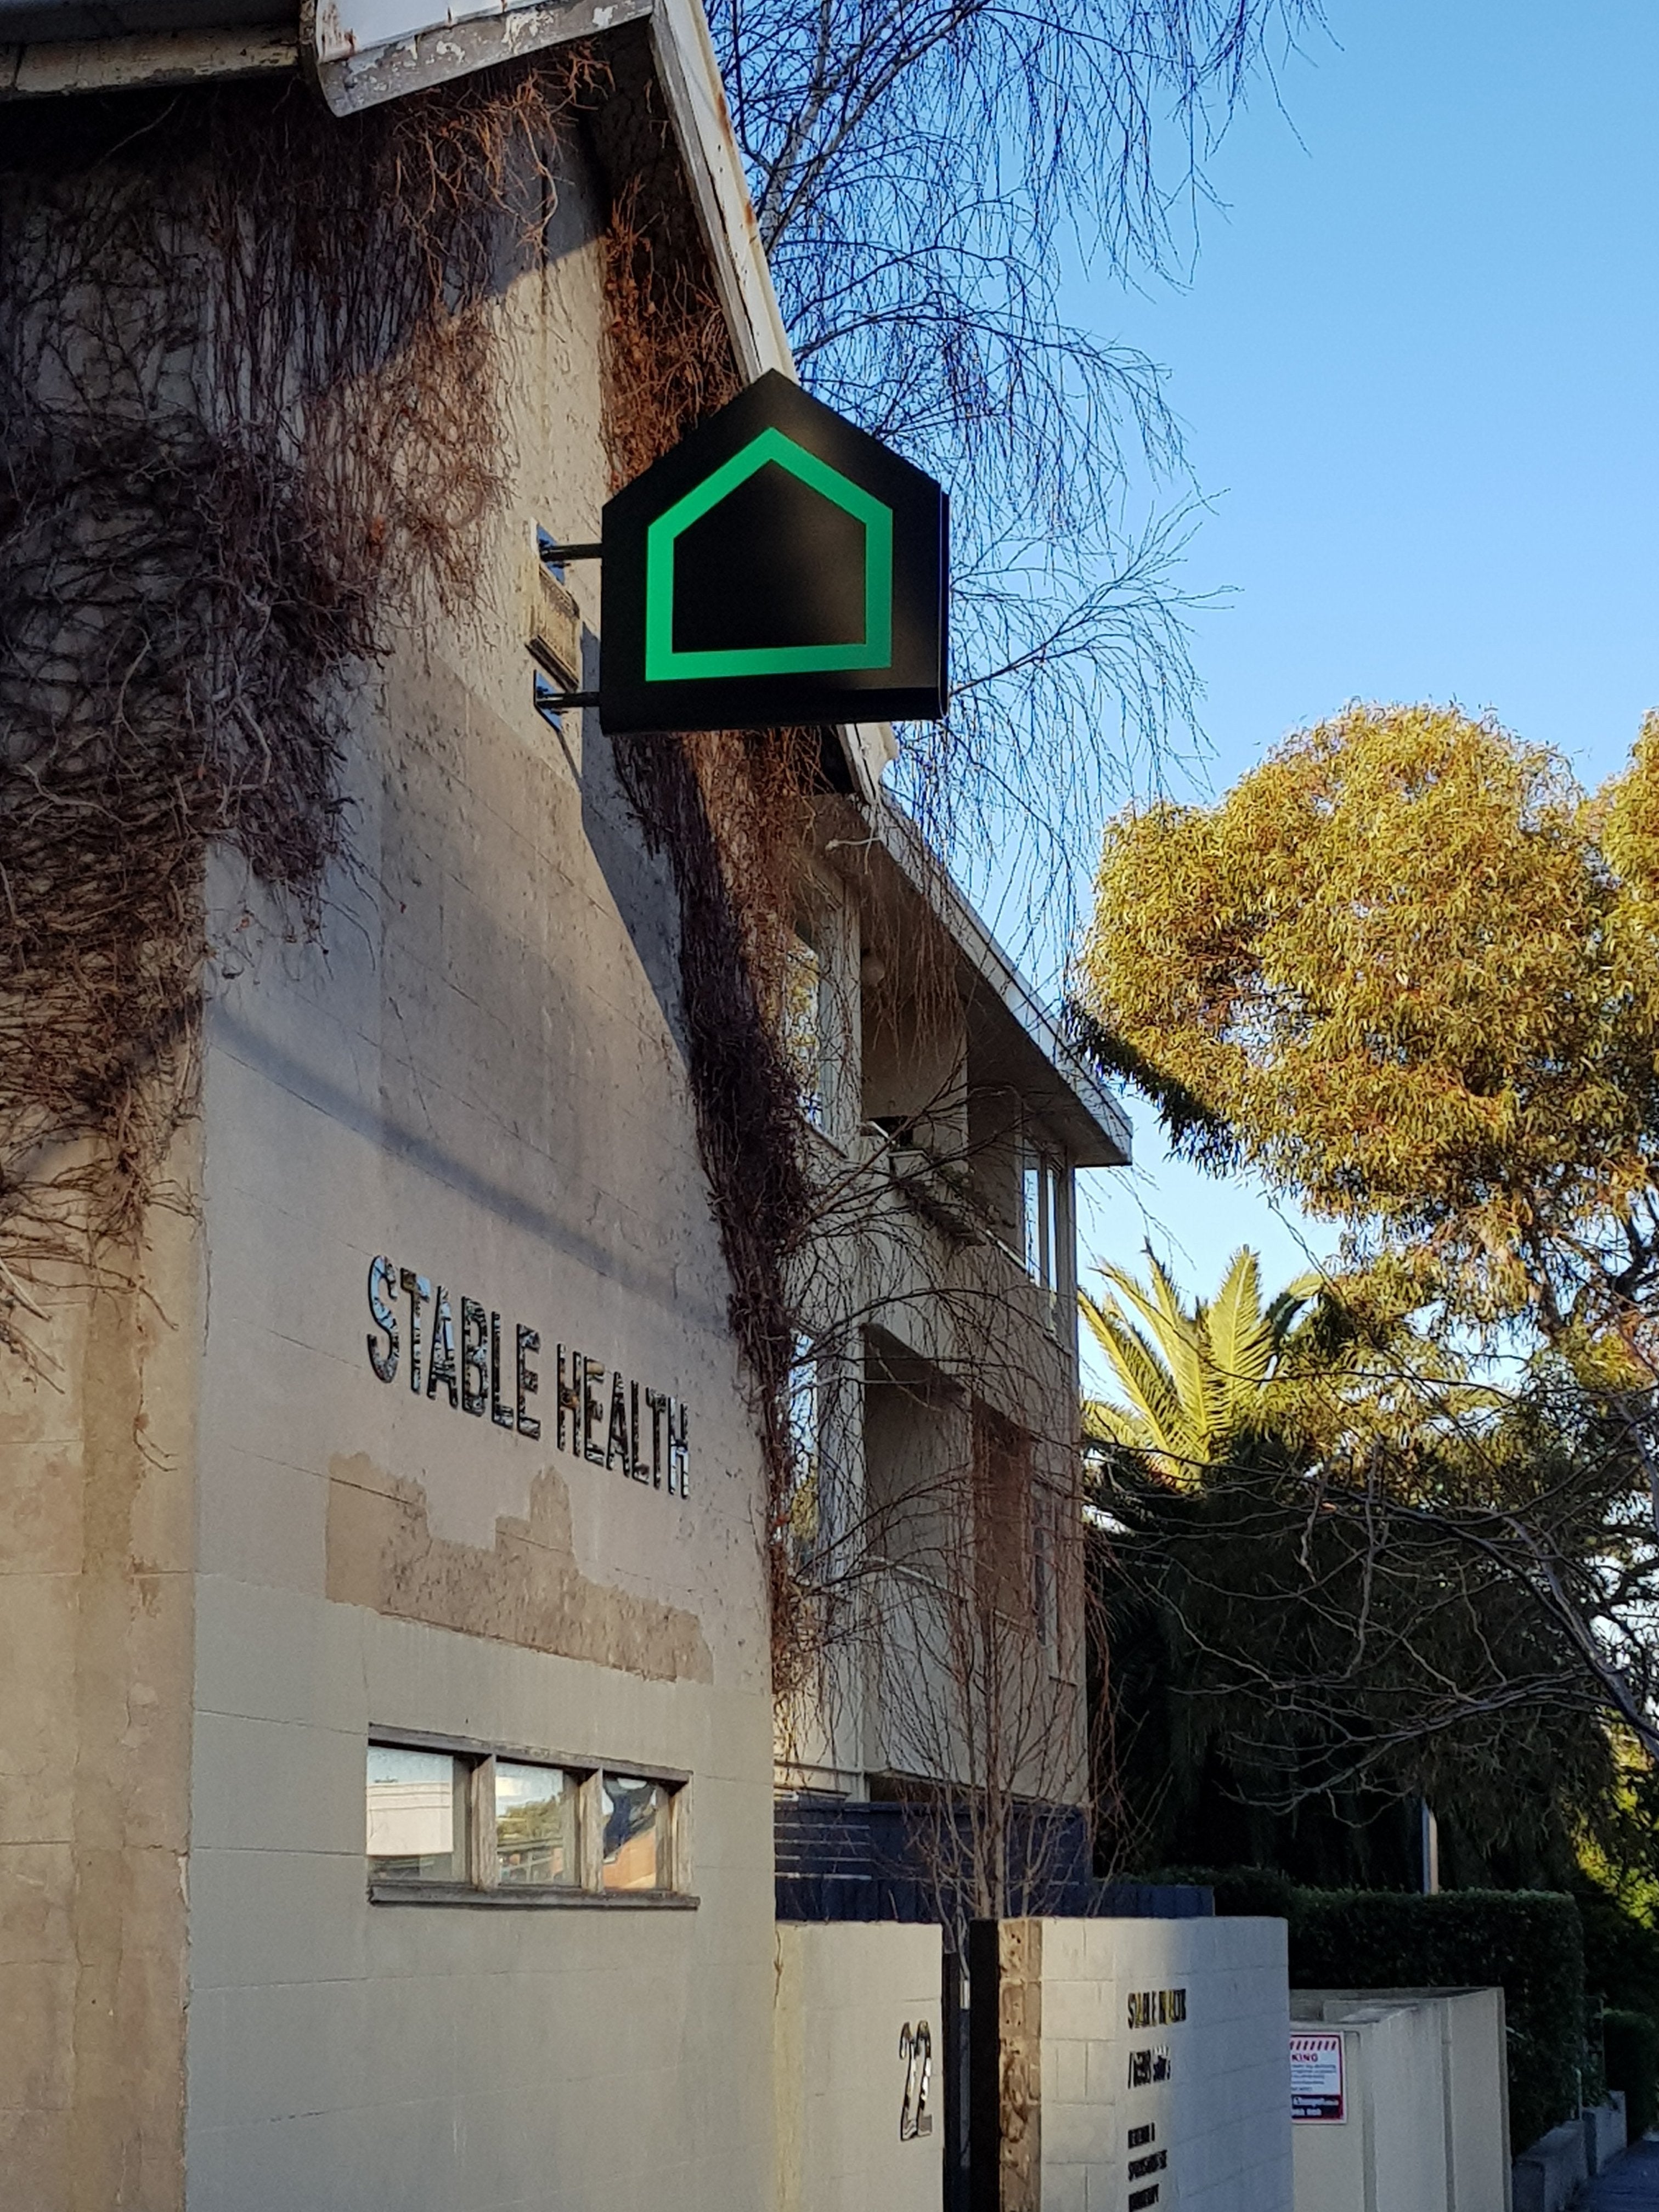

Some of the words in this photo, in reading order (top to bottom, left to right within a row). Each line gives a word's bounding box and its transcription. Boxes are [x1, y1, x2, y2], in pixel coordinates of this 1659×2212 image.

[367, 1255, 541, 1441] STABLE
[557, 1344, 689, 1500] HEALTH
[899, 2019, 932, 2141] 22
